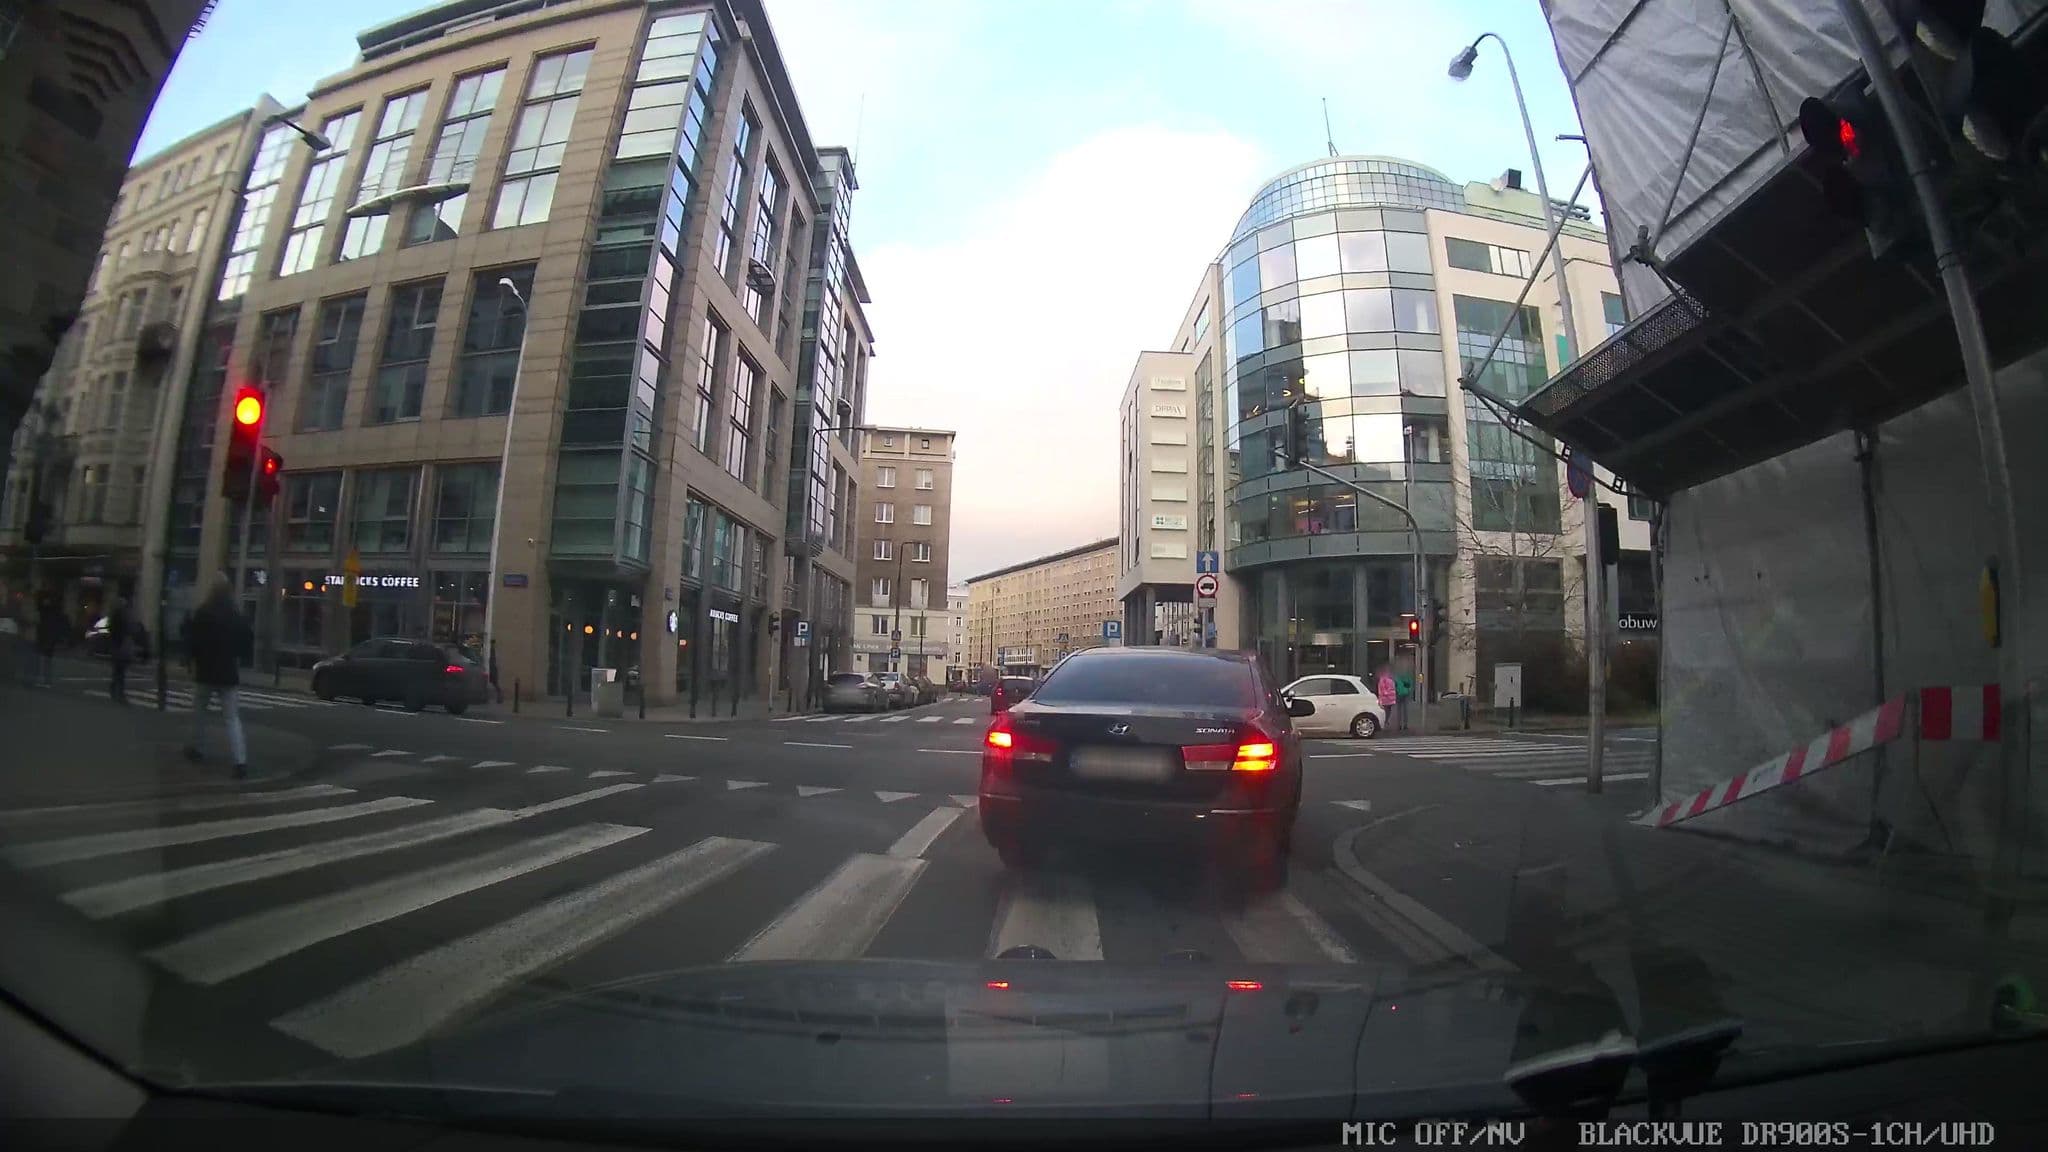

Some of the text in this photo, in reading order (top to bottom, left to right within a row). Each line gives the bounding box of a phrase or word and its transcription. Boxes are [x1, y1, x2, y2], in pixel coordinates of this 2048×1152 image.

[381, 577, 419, 587] COFFEE
[798, 621, 808, 635] P
[1107, 621, 1118, 636] P
[1618, 614, 1658, 630] obuw
